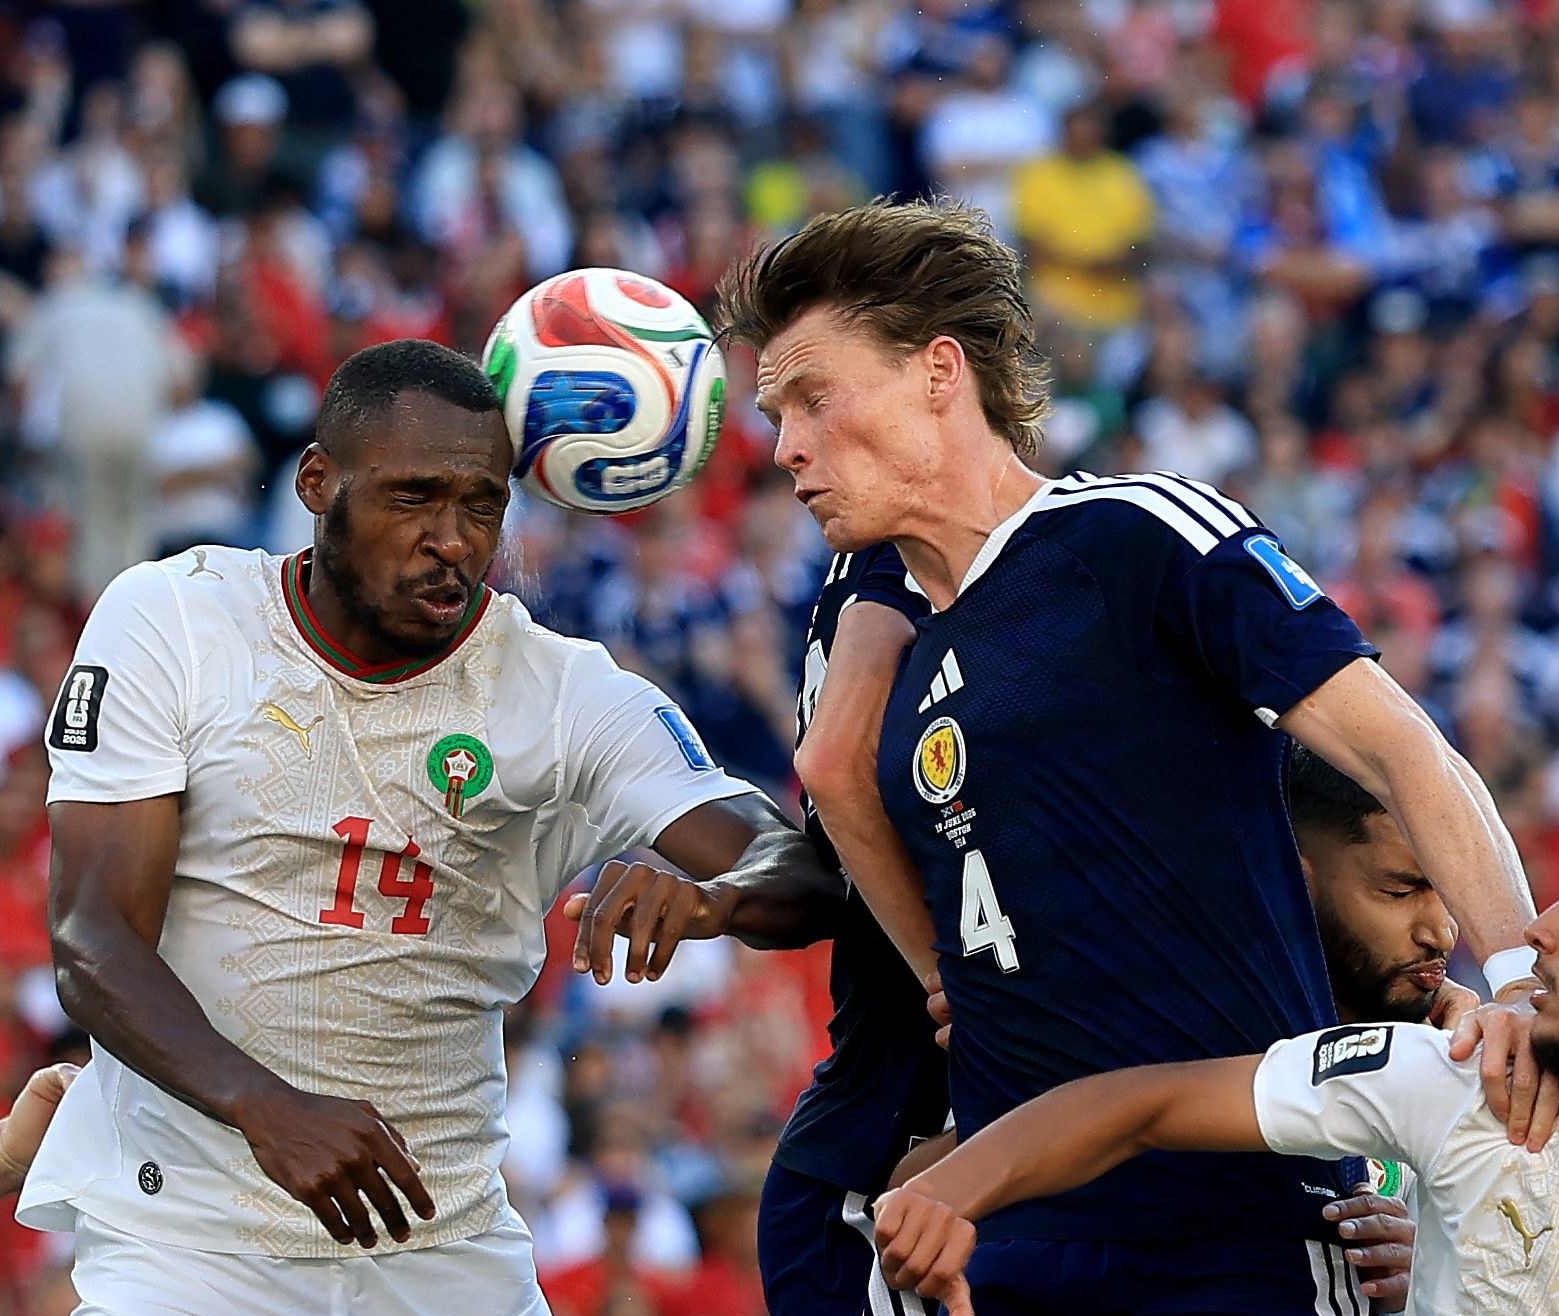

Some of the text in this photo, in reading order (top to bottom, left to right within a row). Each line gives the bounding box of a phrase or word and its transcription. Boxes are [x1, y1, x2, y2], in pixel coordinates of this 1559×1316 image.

[62, 734, 88, 746] 2026
[943, 815, 962, 830] JUNE
[318, 816, 434, 936] 14
[960, 850, 1020, 974] 4
